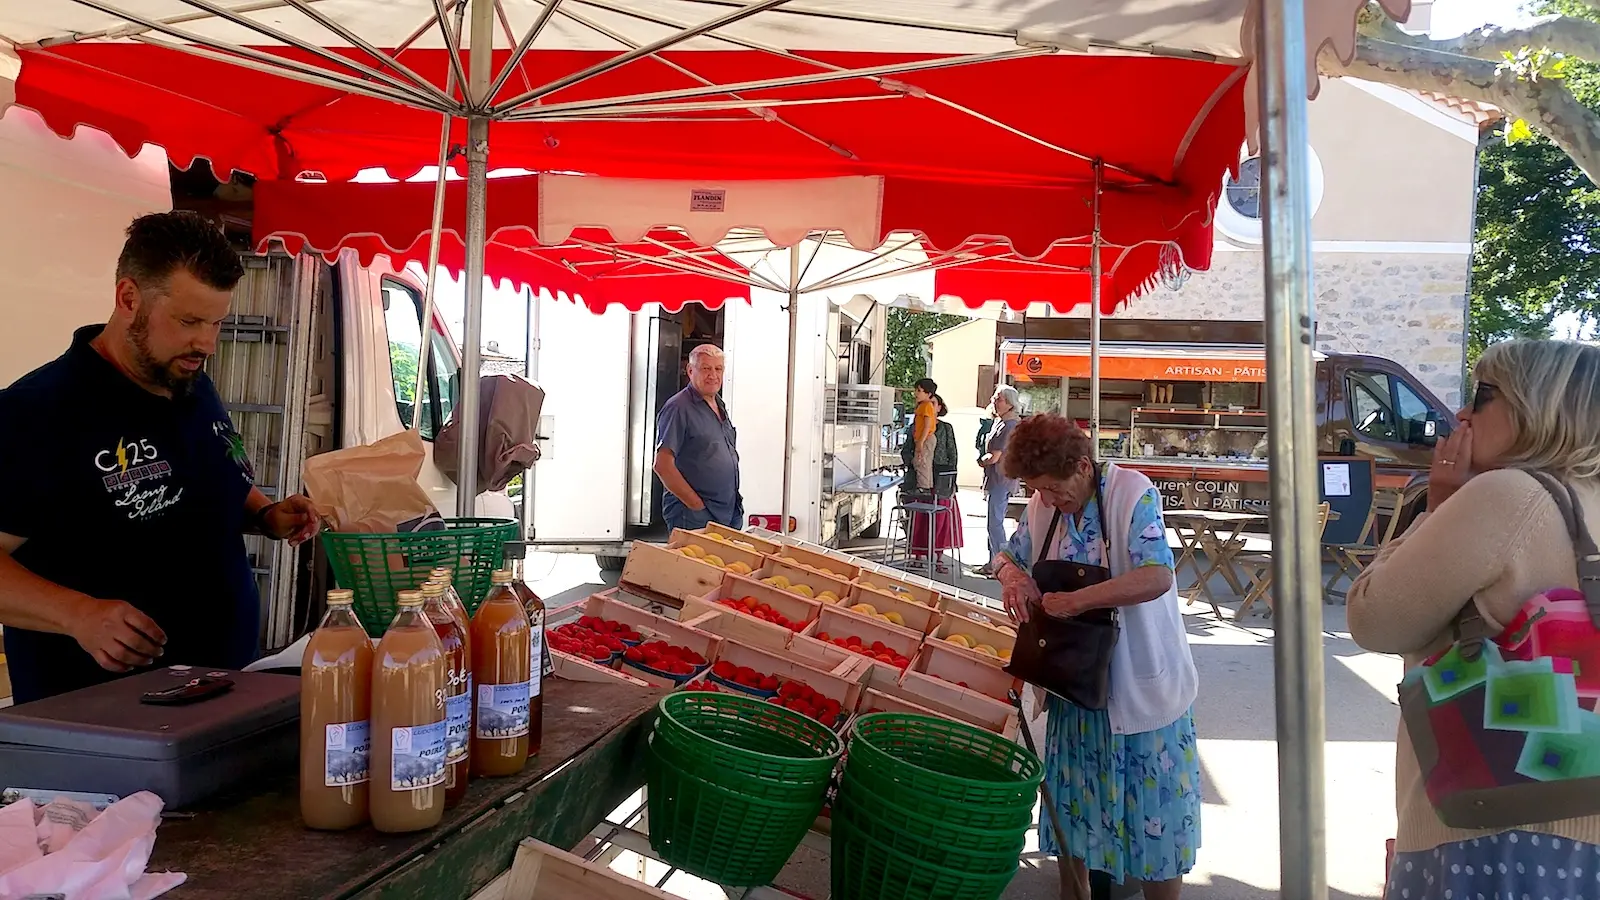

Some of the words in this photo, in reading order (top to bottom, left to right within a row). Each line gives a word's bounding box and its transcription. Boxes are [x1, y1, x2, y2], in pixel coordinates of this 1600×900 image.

[1165, 366, 1222, 377] ARTISAN
[1234, 366, 1267, 377] PÂTIS
[1195, 480, 1239, 494] COLIN
